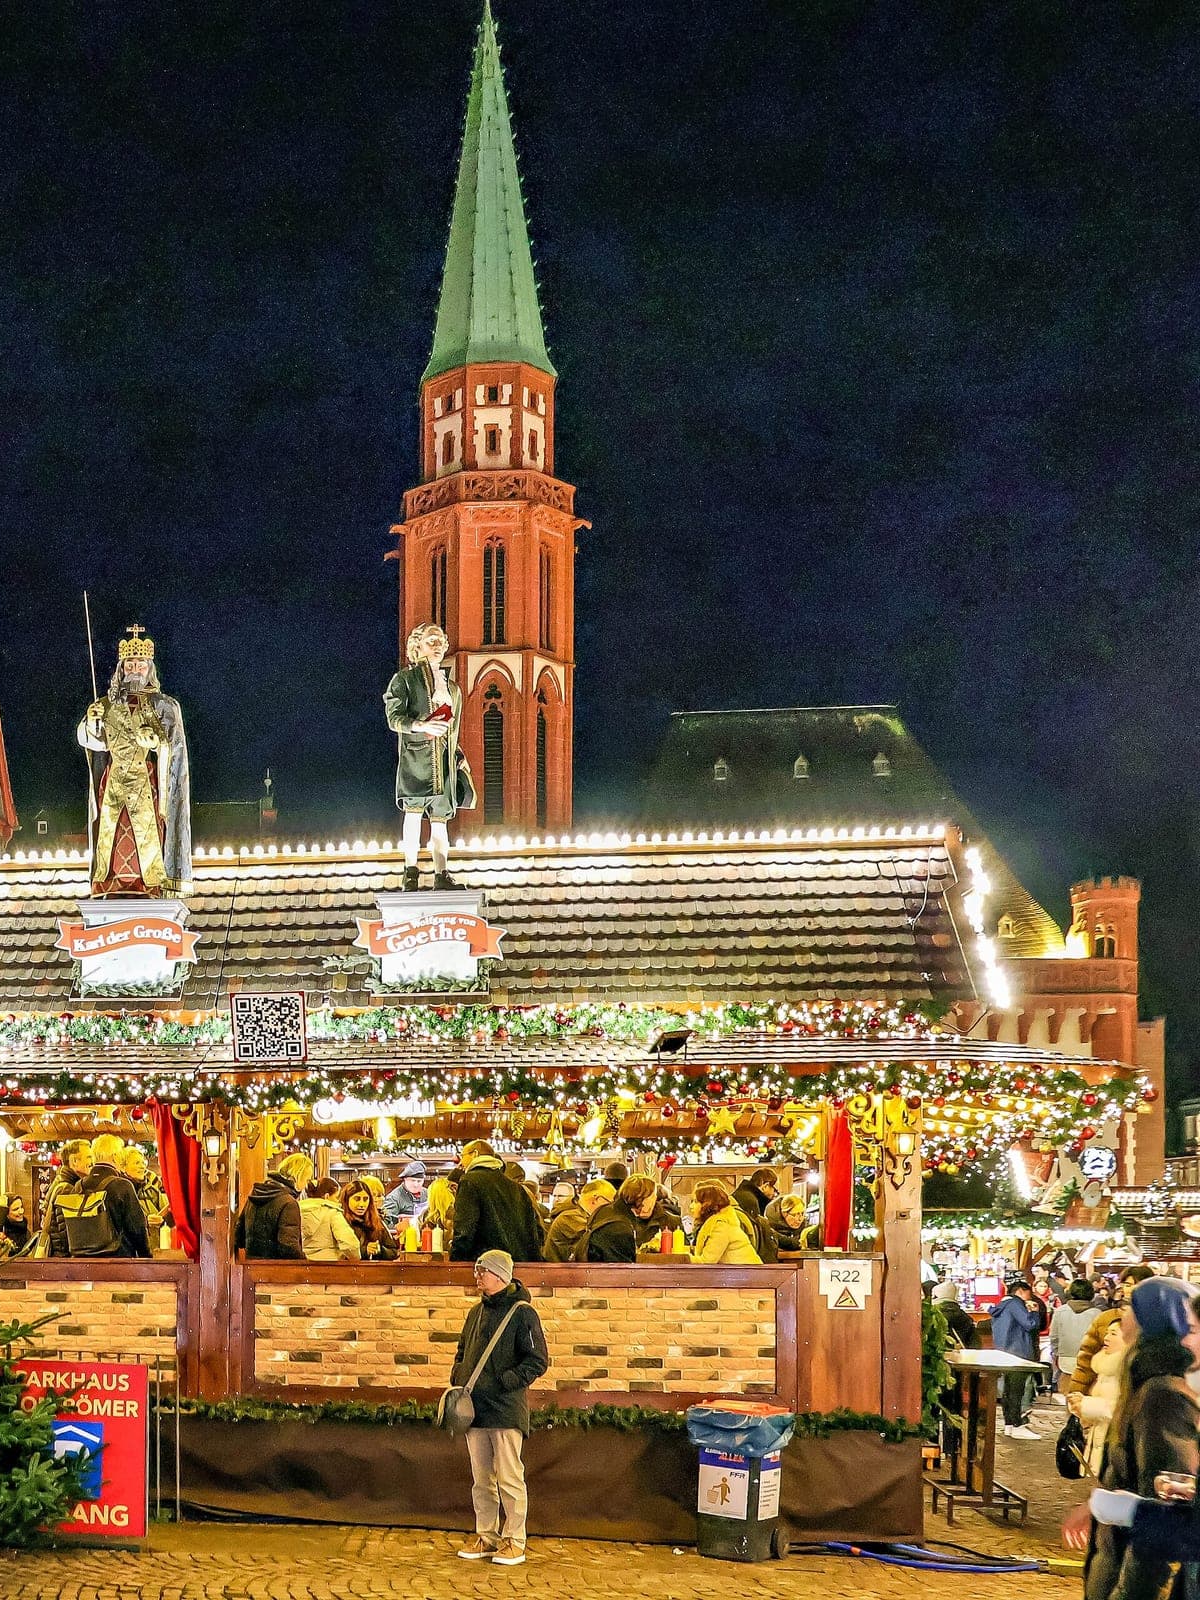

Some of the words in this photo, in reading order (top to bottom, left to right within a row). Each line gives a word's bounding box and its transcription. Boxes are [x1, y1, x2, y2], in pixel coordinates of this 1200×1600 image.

[458, 917, 477, 927] von
[73, 934, 106, 952] Karl
[106, 930, 131, 944] der
[133, 925, 182, 944] Große
[386, 922, 468, 953] Goethe
[830, 1269, 860, 1283] R22
